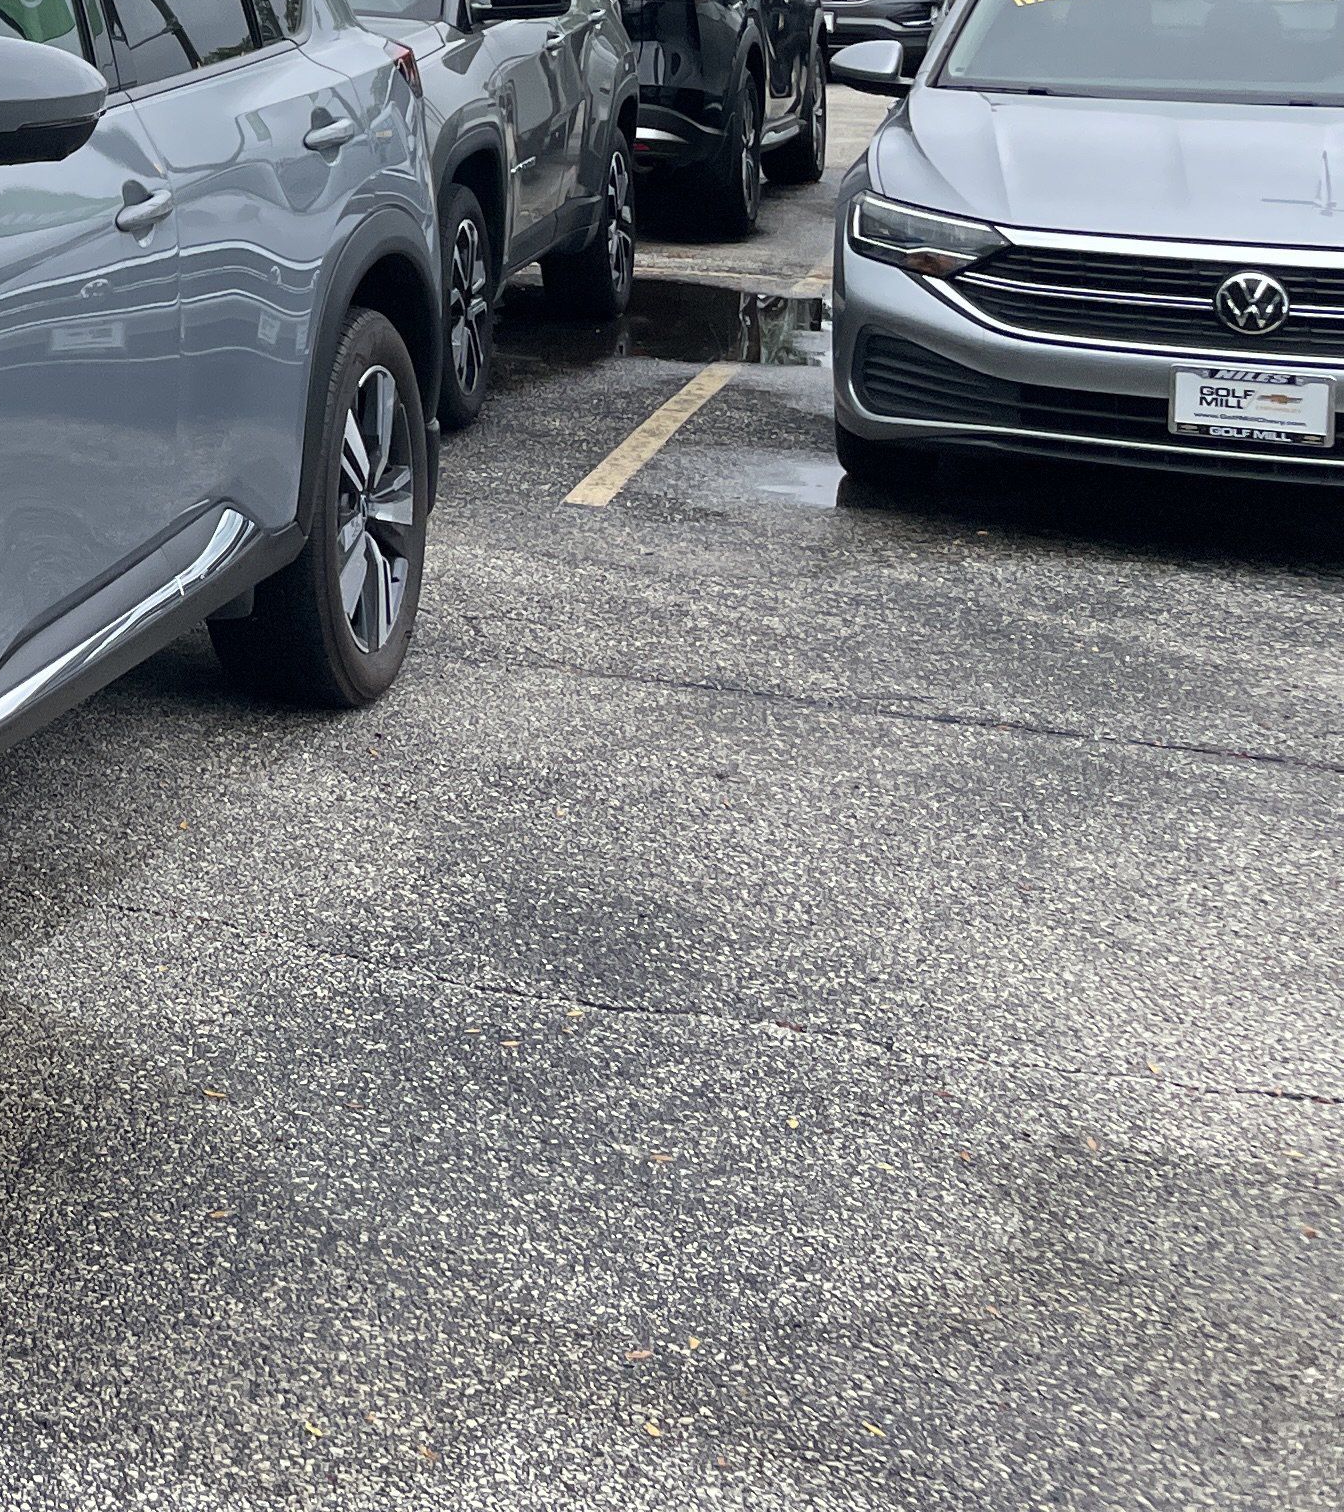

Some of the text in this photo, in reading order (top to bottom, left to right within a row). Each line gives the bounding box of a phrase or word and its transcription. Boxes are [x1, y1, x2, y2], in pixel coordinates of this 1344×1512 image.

[1214, 369, 1292, 385] NILES
[1199, 385, 1256, 399] GOLF
[1199, 396, 1245, 409] MILL
[1209, 425, 1292, 442] GOLF MILL
